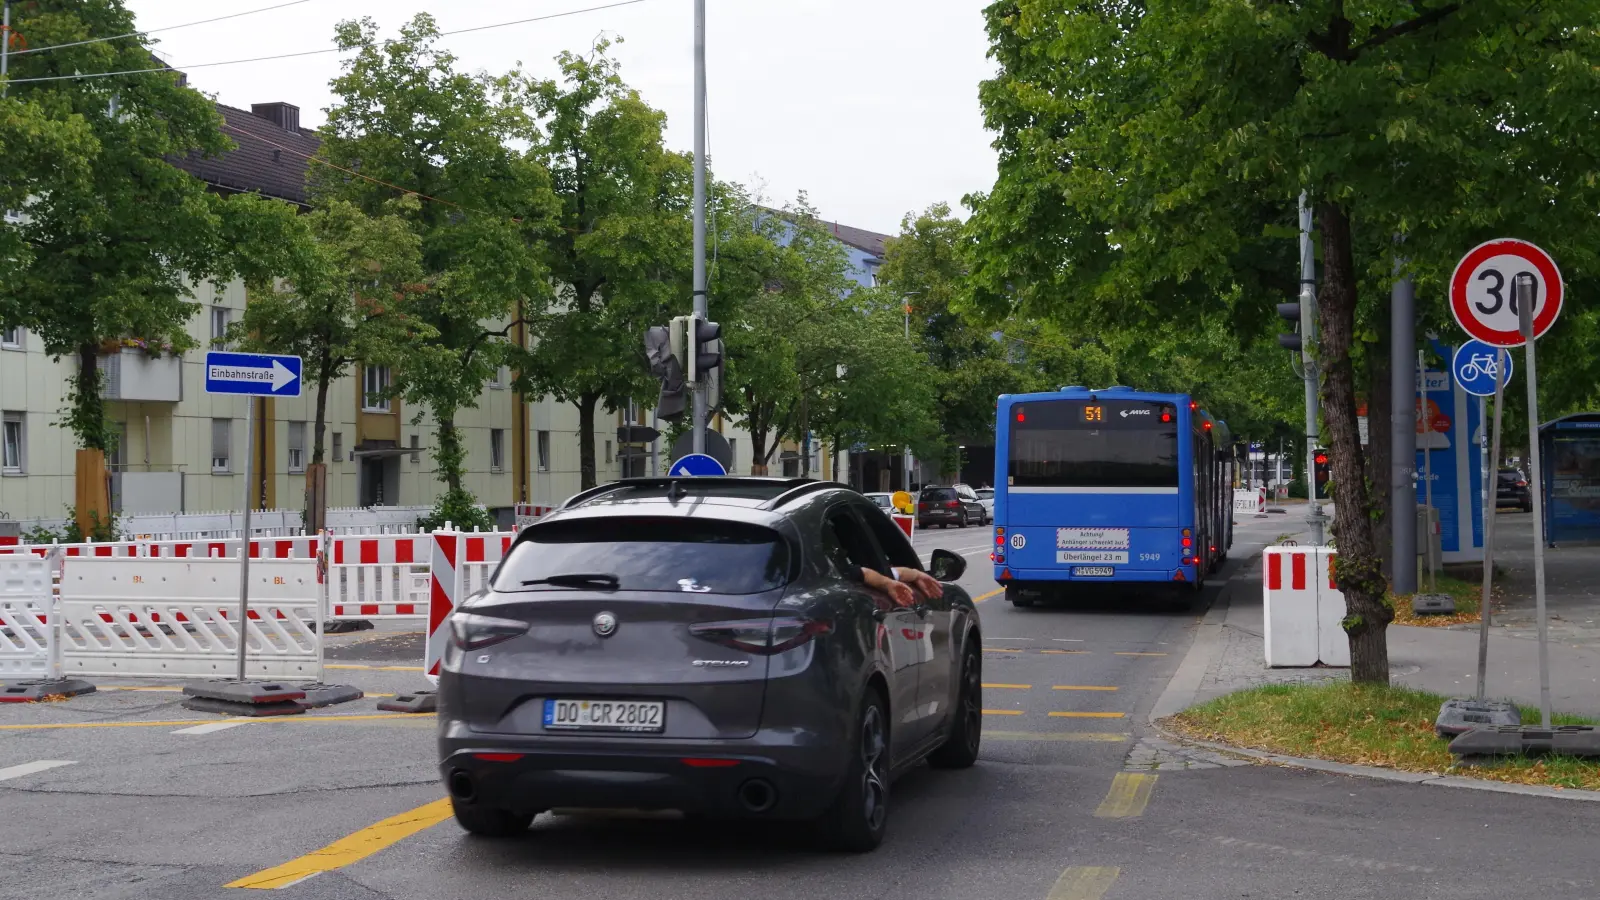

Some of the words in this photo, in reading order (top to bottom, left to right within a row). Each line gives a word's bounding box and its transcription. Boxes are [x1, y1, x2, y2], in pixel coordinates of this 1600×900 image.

[1475, 269, 1538, 316] 30
[211, 368, 274, 380] Einbahnstraße
[1085, 406, 1101, 421] 51
[1013, 536, 1024, 547] 80
[1063, 552, 1102, 562] Überlänge!
[1139, 553, 1161, 561] 5949
[132, 575, 145, 584] BL
[274, 576, 287, 585] BL
[692, 659, 749, 667] STELVIO
[557, 702, 579, 722] DO
[591, 703, 613, 724] CR
[616, 704, 659, 725] 2802
